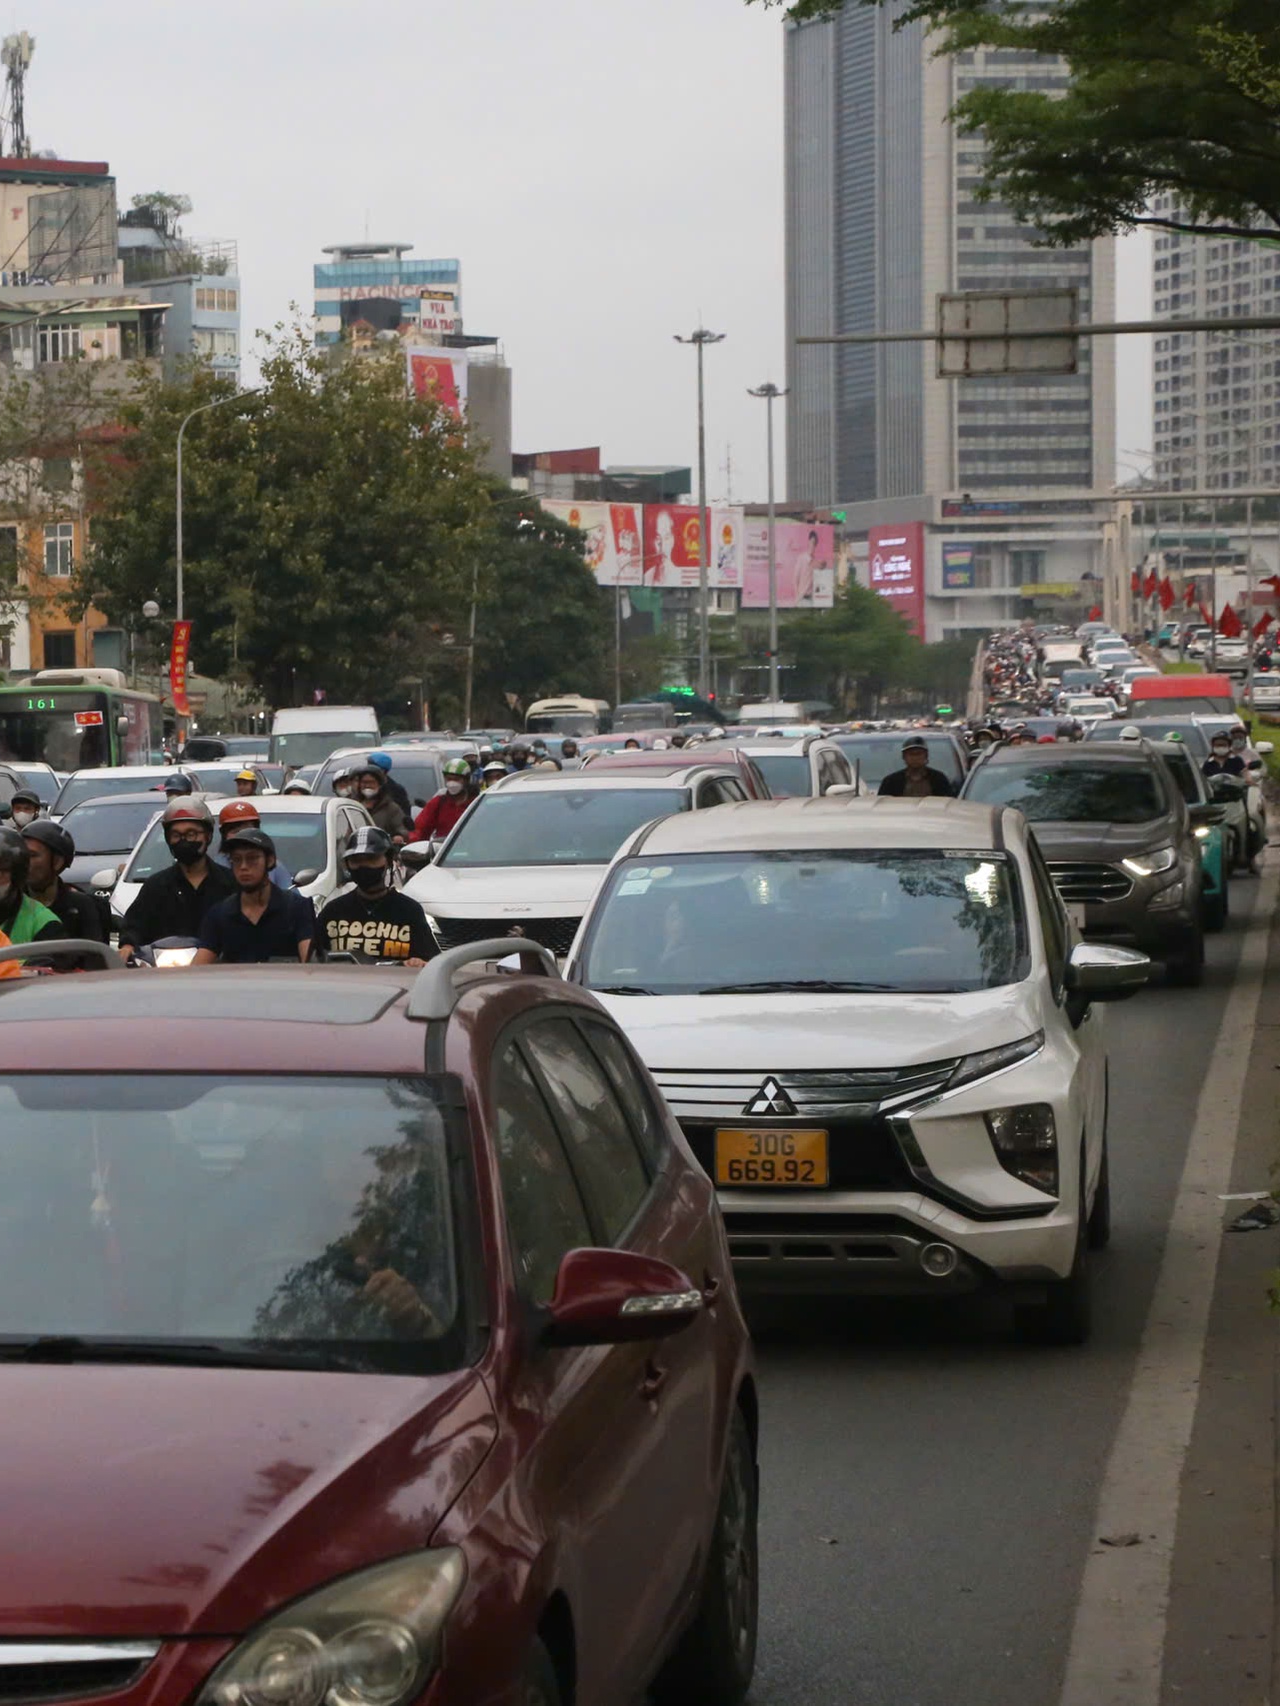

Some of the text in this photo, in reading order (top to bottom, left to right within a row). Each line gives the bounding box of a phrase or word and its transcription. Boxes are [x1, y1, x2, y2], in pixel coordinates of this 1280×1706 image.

[430, 302, 446, 315] VUA
[28, 699, 55, 709] 161
[749, 1133, 795, 1156] 30G
[728, 1159, 815, 1182] 669.92
